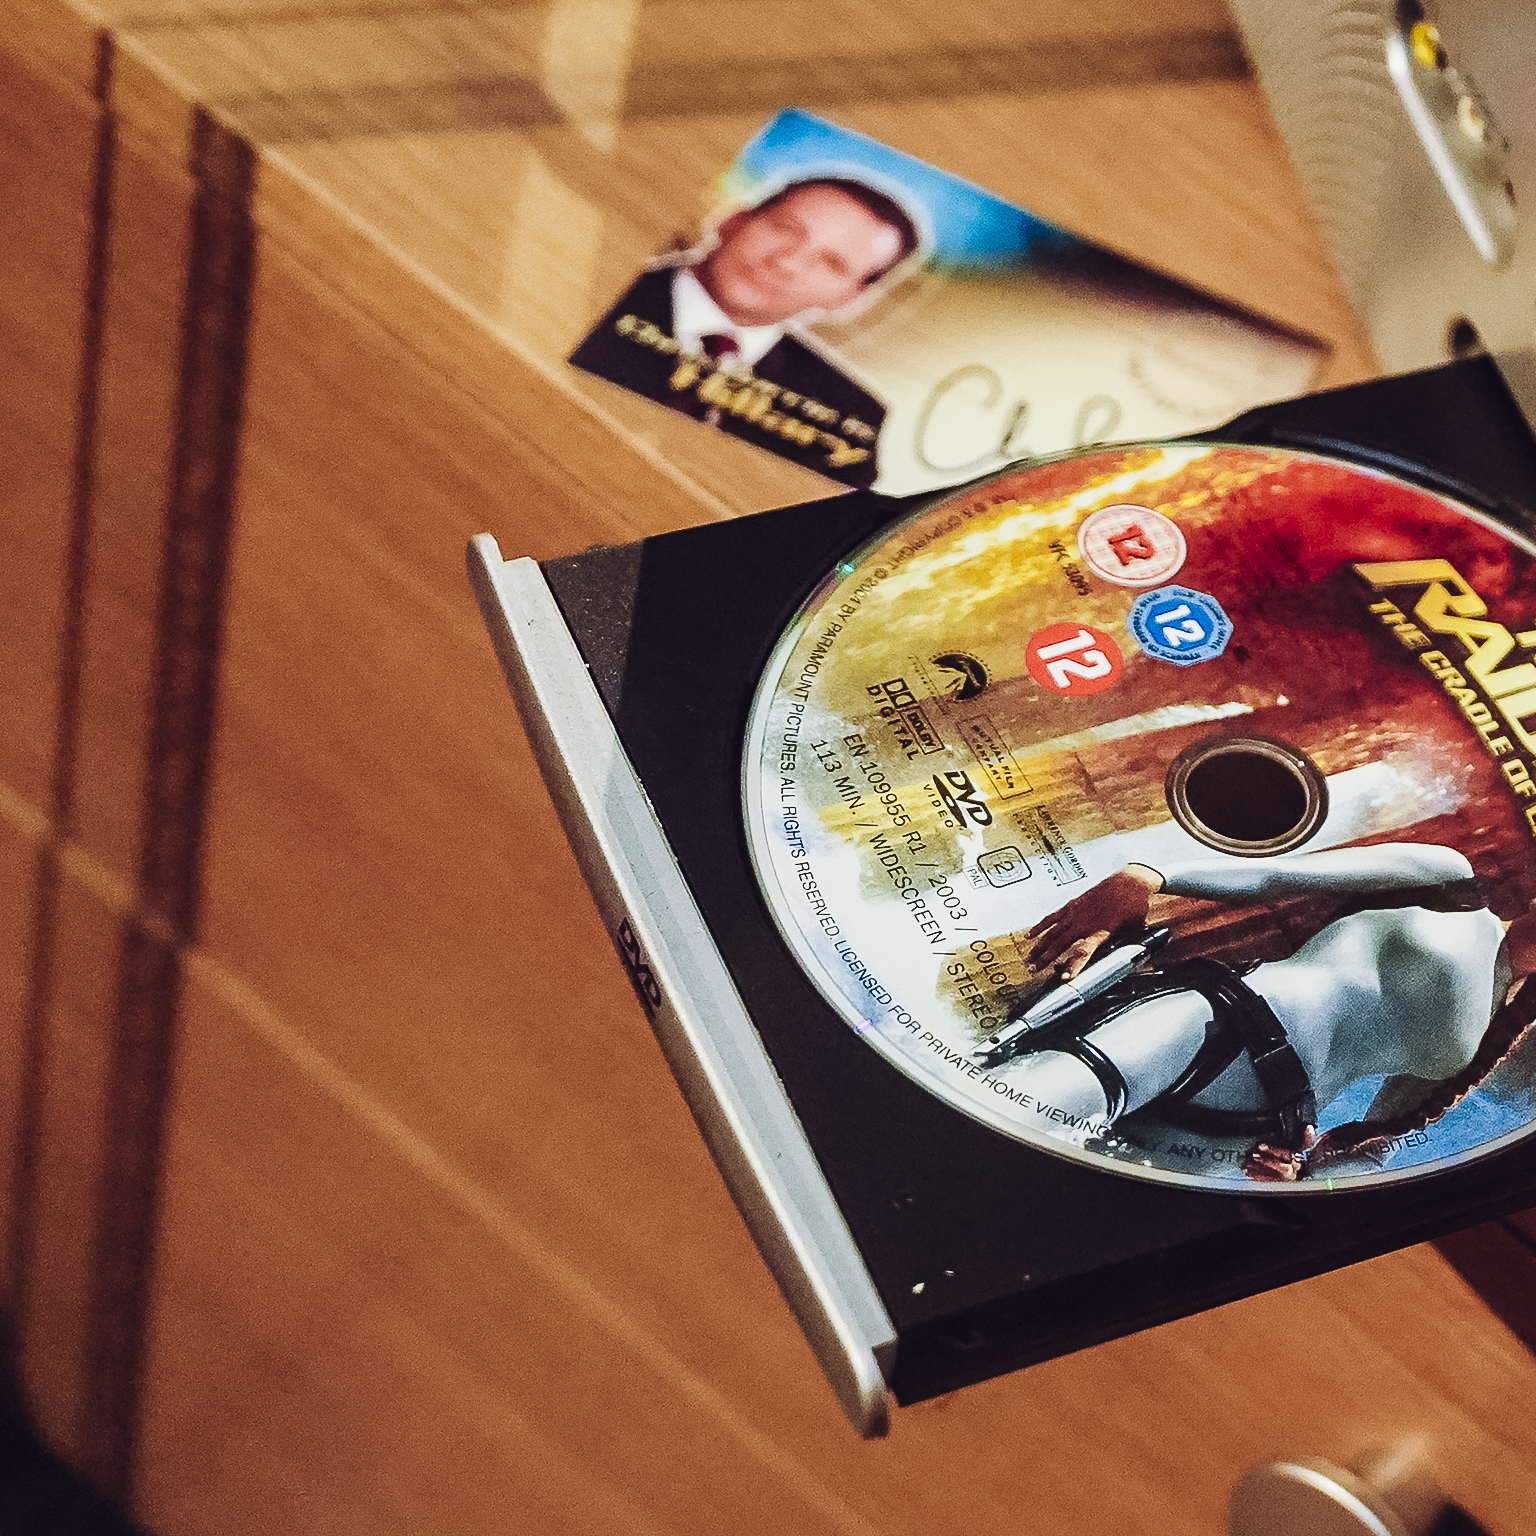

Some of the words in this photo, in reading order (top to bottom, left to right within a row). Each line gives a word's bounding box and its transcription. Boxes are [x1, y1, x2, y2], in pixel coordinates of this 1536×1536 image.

[1109, 525, 1156, 566] 12
[838, 603, 857, 624] BY
[850, 577, 878, 605] 2004
[1155, 605, 1204, 646] 12
[793, 621, 842, 702] PARAMOUNT
[1037, 629, 1112, 688] 12
[1369, 599, 1431, 649] THE
[1419, 651, 1513, 756] CRADLE
[1501, 759, 1536, 798] OF
[867, 685, 921, 761] DIGITAL
[906, 712, 937, 748] DOLBY
[779, 777, 796, 803] ALL
[922, 783, 954, 829] VIDEO
[943, 770, 993, 827] DVD
[780, 806, 806, 859] RIGHTS
[843, 733, 869, 758] EN
[860, 761, 912, 827] 109955
[902, 831, 927, 856] R1
[928, 874, 968, 921] 2003
[810, 739, 842, 774] 113
[832, 775, 866, 816] MIN.
[868, 832, 947, 947] WIDESCREEN
[946, 962, 999, 1030] STEREO
[967, 868, 984, 887] PAL
[993, 860, 1015, 875] 2
[794, 861, 841, 941] RESERVED.
[617, 916, 662, 1007] DVD
[834, 939, 893, 1007] LICENSED
[888, 1004, 921, 1035] FOR
[918, 1032, 984, 1080] PRIVATE
[981, 1073, 1034, 1109] HOME
[1035, 1101, 1114, 1139] VIEWING
